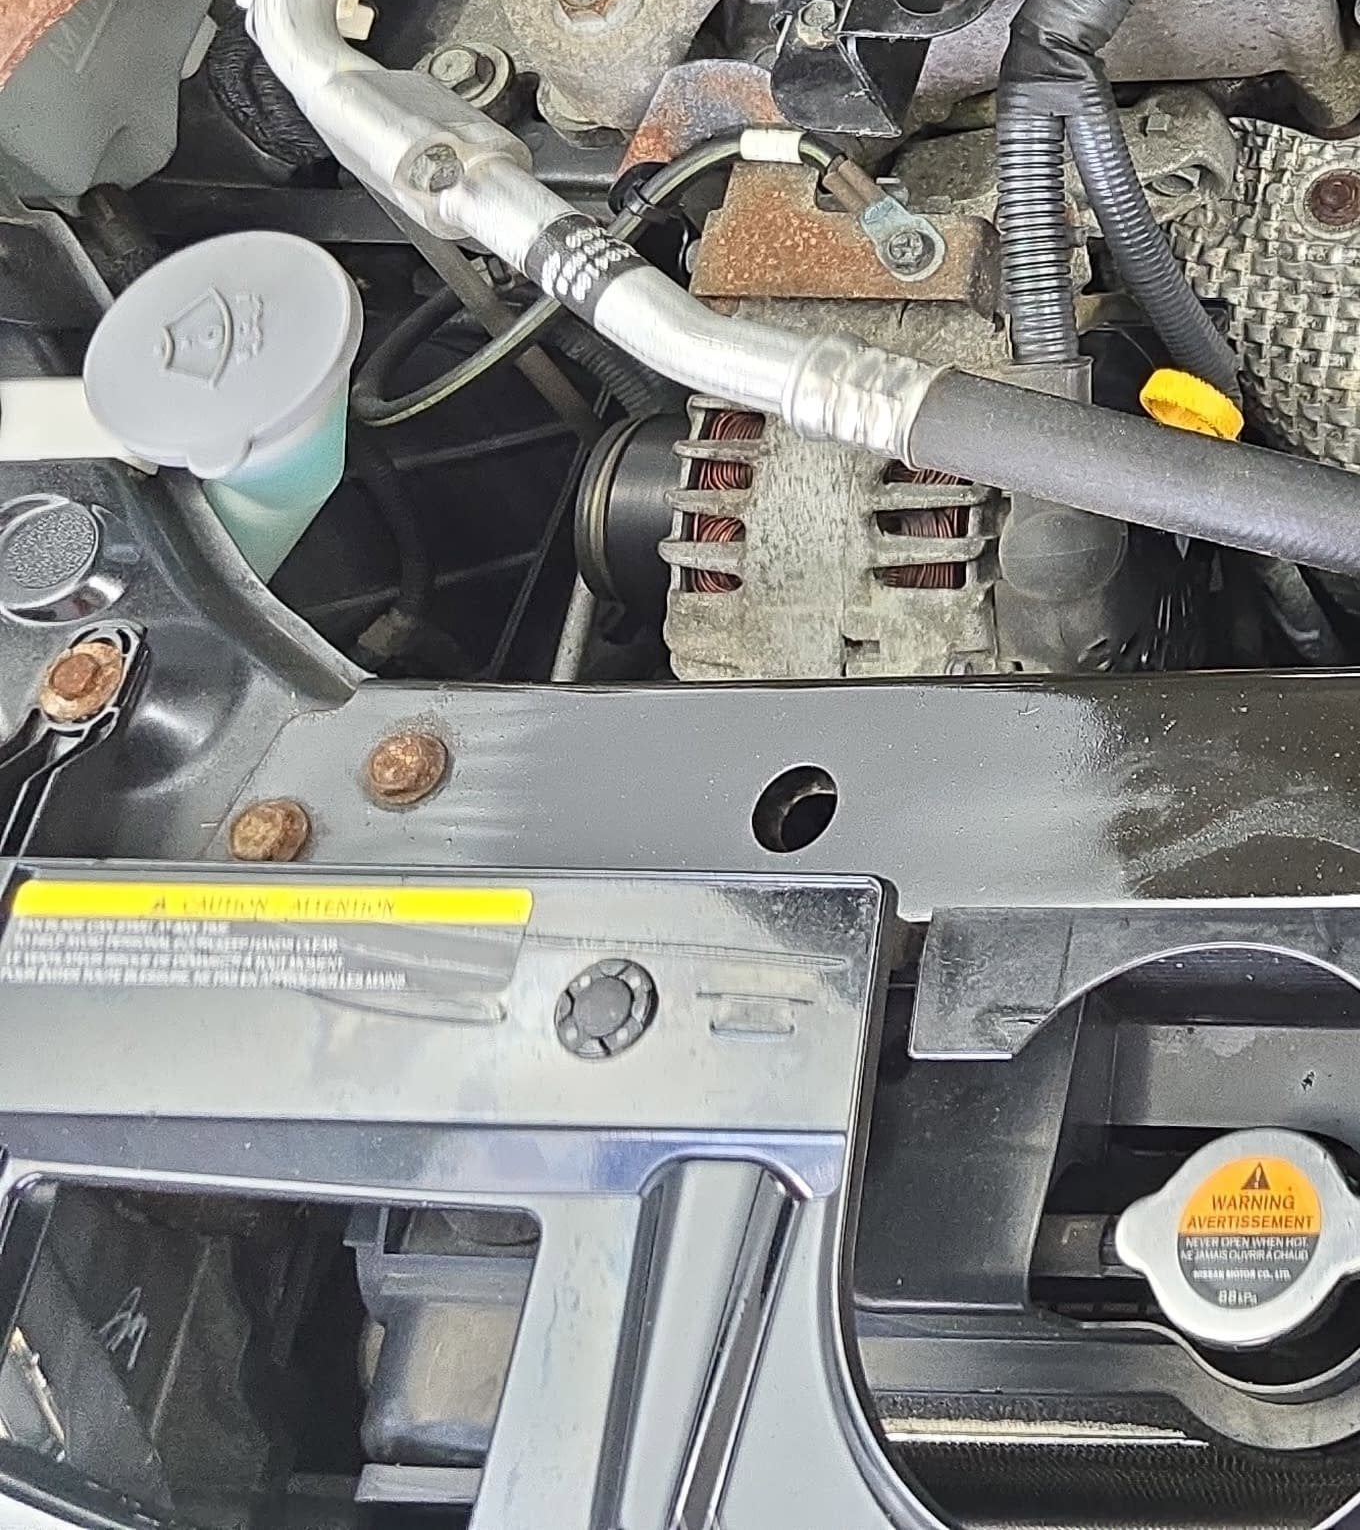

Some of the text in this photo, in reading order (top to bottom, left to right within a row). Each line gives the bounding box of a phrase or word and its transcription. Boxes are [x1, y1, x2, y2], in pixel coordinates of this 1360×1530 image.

[1211, 1193, 1296, 1211] WARNING
[1186, 1214, 1314, 1230] AVERTISSEMENT
[1186, 1236, 1220, 1249] NEVER
[1221, 1236, 1251, 1249] OPEN
[1252, 1236, 1284, 1250] WHEN
